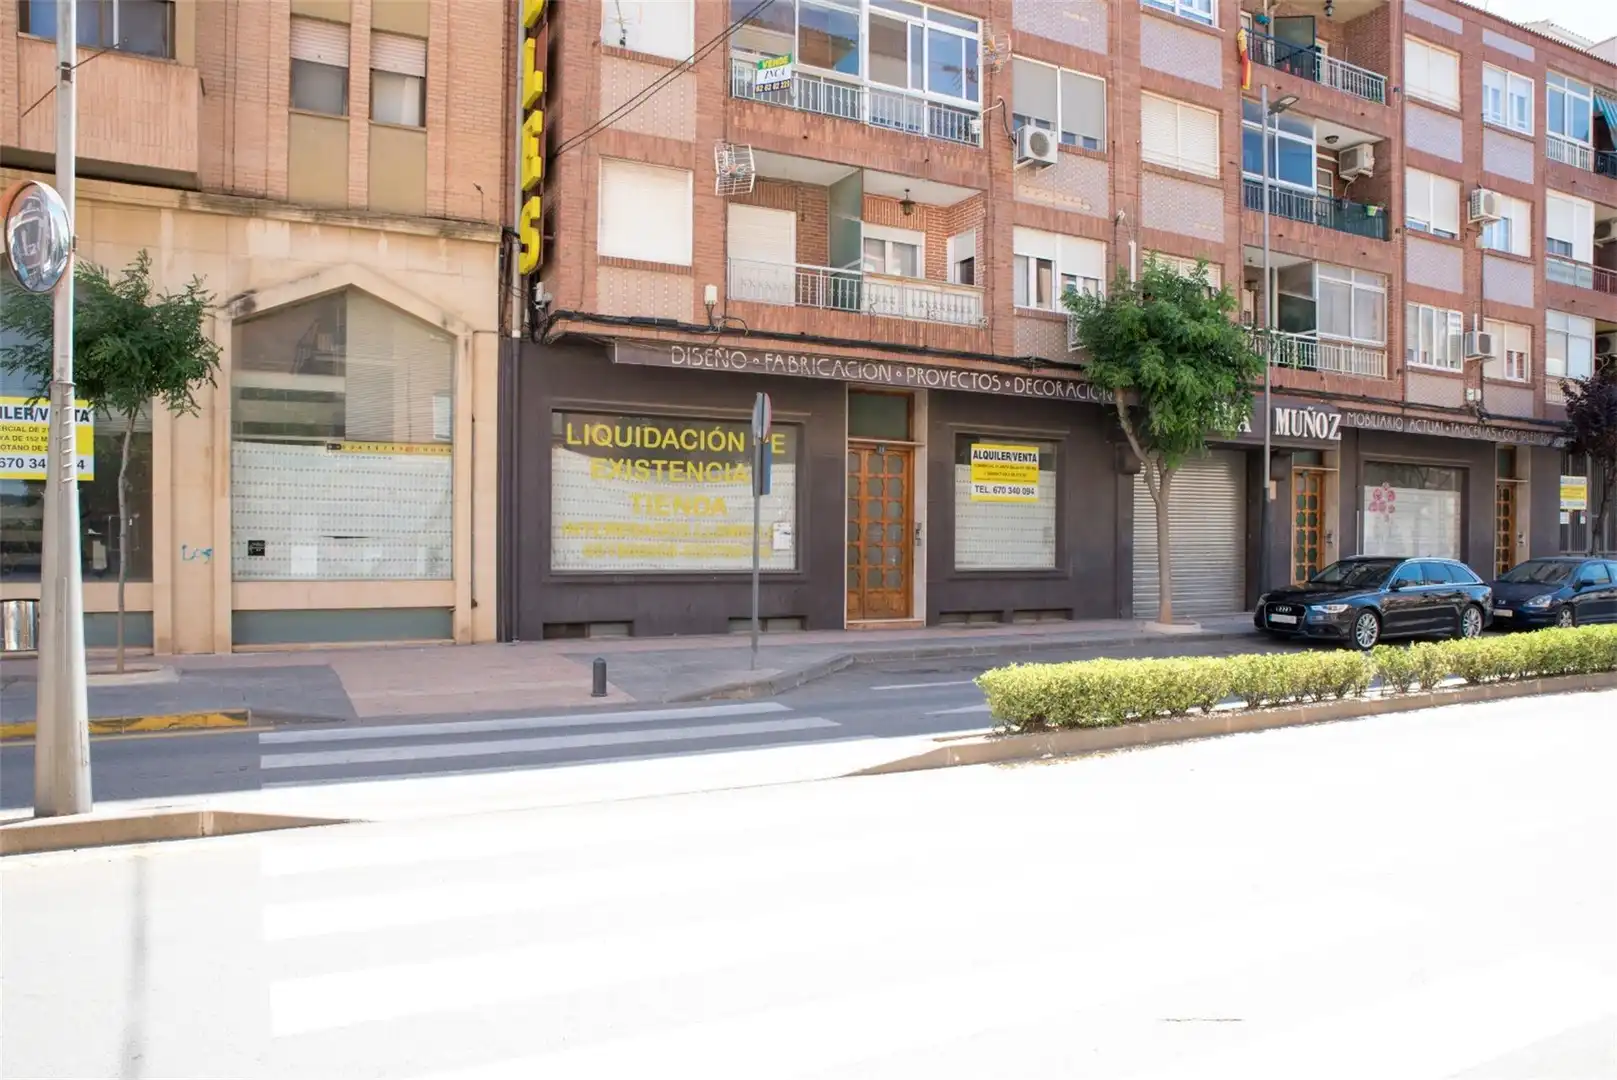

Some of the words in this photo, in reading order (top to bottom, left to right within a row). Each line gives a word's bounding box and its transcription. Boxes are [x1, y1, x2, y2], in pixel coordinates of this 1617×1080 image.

[671, 345, 747, 370] DISEÑO
[764, 353, 892, 382] FABRICACION
[906, 366, 1001, 392] PROYECTOS
[0, 406, 90, 422] ILER/VTA
[1274, 406, 1342, 440] MUÑOZ
[1346, 412, 1404, 430] MOBILIARIO
[566, 422, 745, 453] LIQUIDACIÓN
[29, 458, 46, 469] 34
[973, 450, 1037, 462] ALQUILER/VENTA
[590, 457, 751, 484] EXISTENCIA
[629, 494, 728, 517] TIENDA
